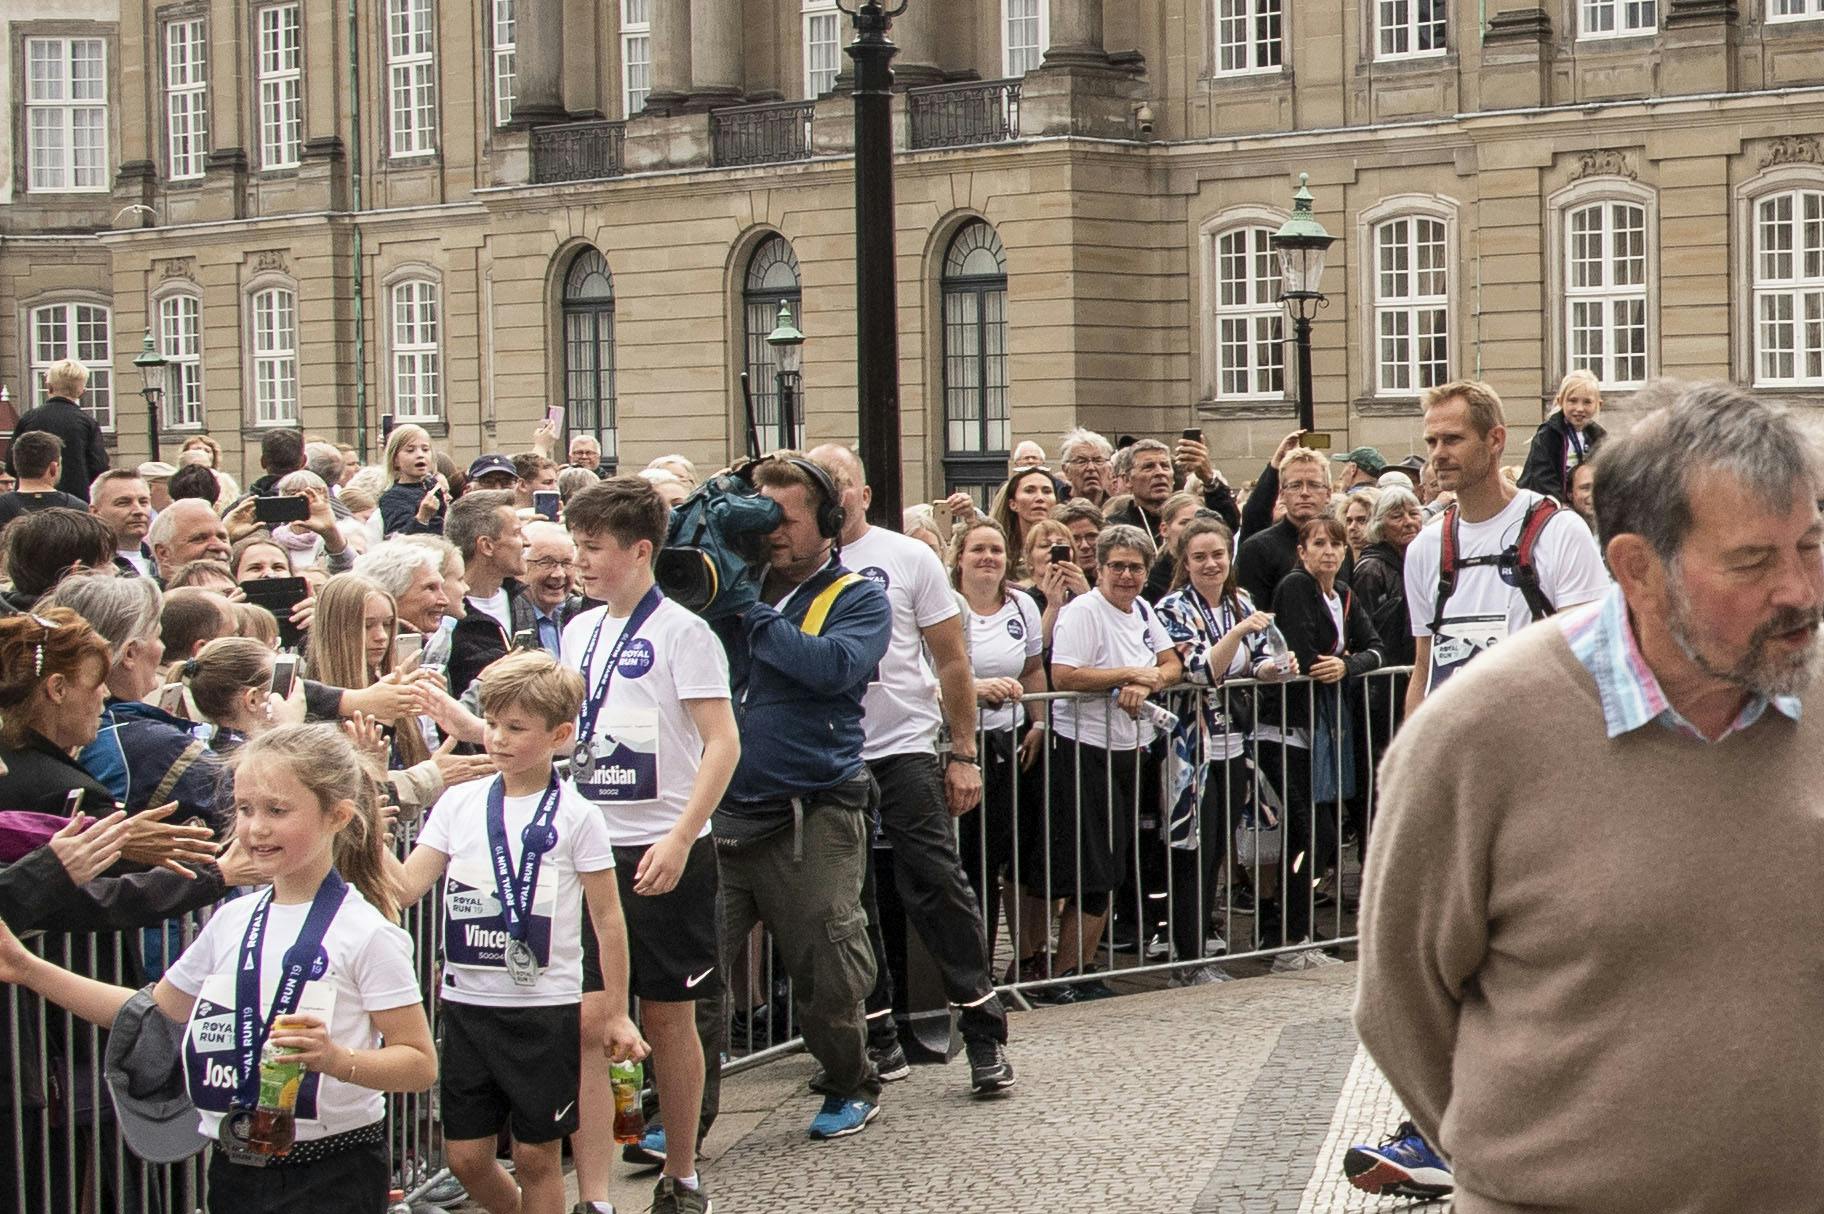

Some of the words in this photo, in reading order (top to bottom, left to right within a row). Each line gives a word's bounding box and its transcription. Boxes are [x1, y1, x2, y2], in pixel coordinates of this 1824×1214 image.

[494, 845, 504, 855] 19
[527, 851, 537, 862] 19
[497, 855, 508, 876] RUN
[523, 862, 535, 882] RUN
[453, 896, 483, 906] ROYAL
[501, 876, 516, 907] ROYAL
[520, 884, 531, 912] OYAL
[452, 904, 472, 913] RUN
[280, 978, 298, 1005] RUN
[290, 964, 303, 977] 19
[242, 1006, 254, 1019] 19
[200, 1032, 225, 1044] RUN
[242, 1020, 254, 1048] RUN
[243, 1050, 254, 1081] YAL
